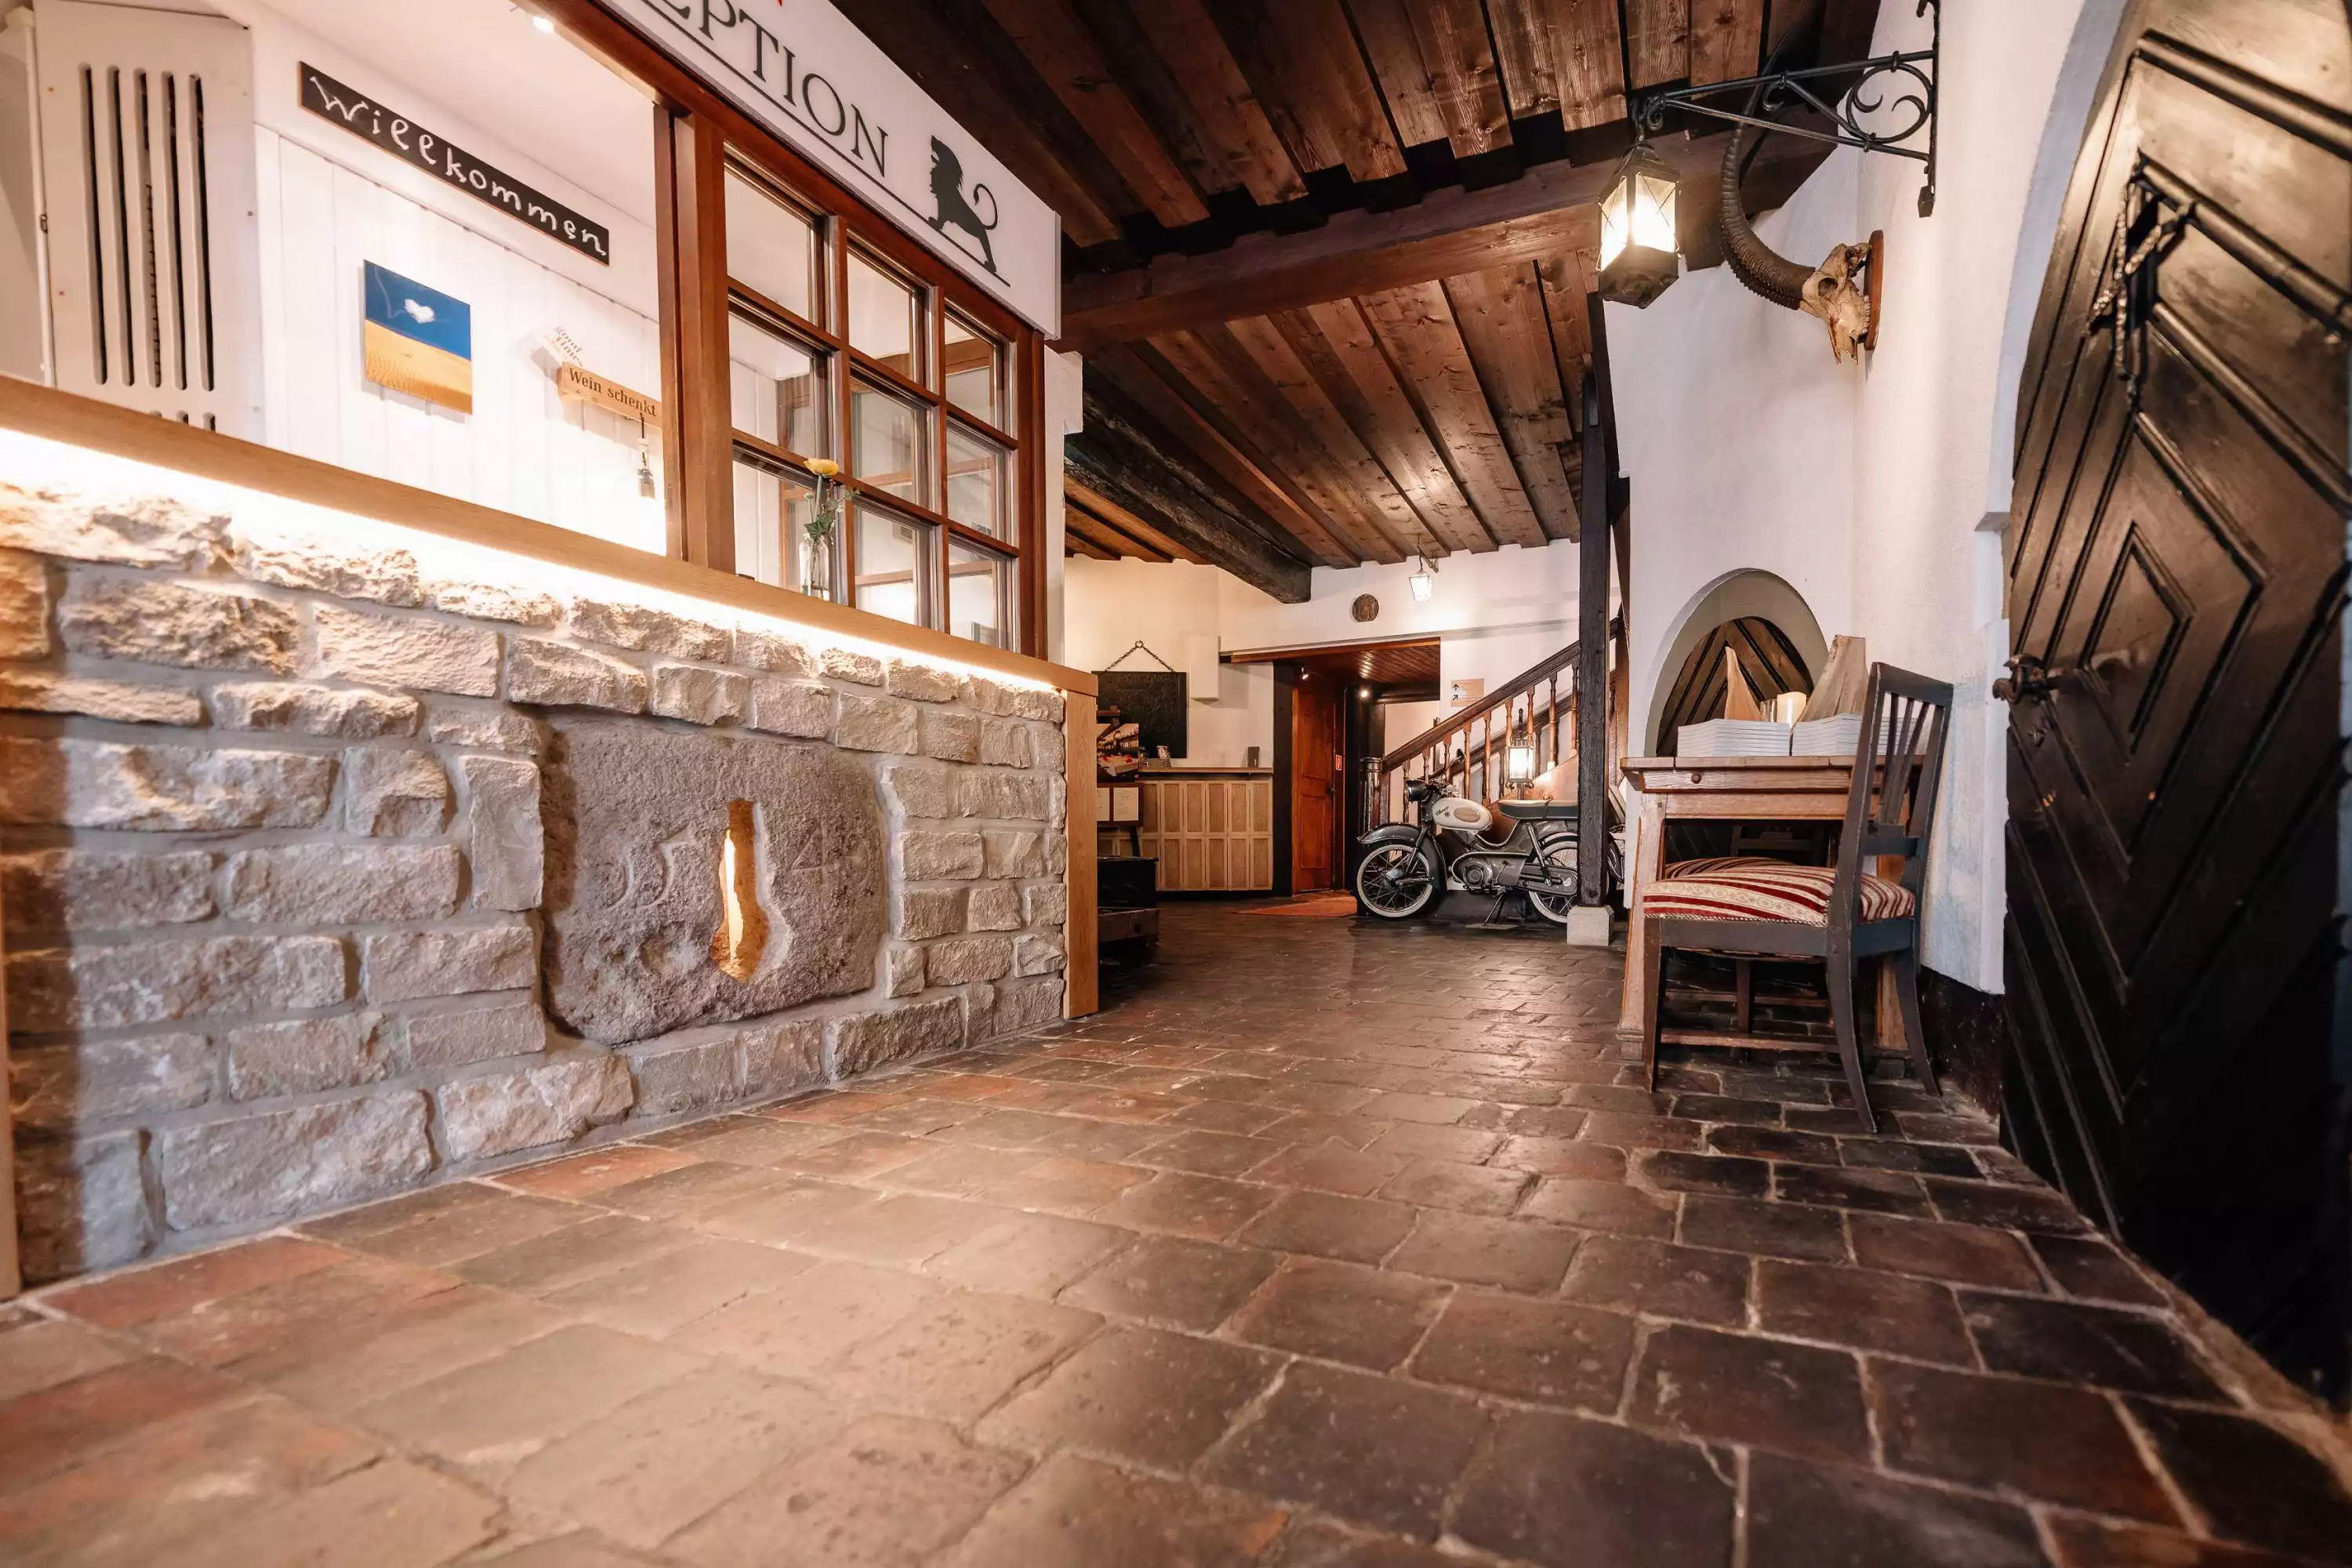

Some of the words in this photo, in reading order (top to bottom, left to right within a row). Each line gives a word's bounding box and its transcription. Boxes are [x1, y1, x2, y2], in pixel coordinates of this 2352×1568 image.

[310, 76, 607, 256] Willkommen
[662, 0, 888, 177] PTION
[568, 367, 602, 394] Wein
[607, 387, 657, 417] schenkt
